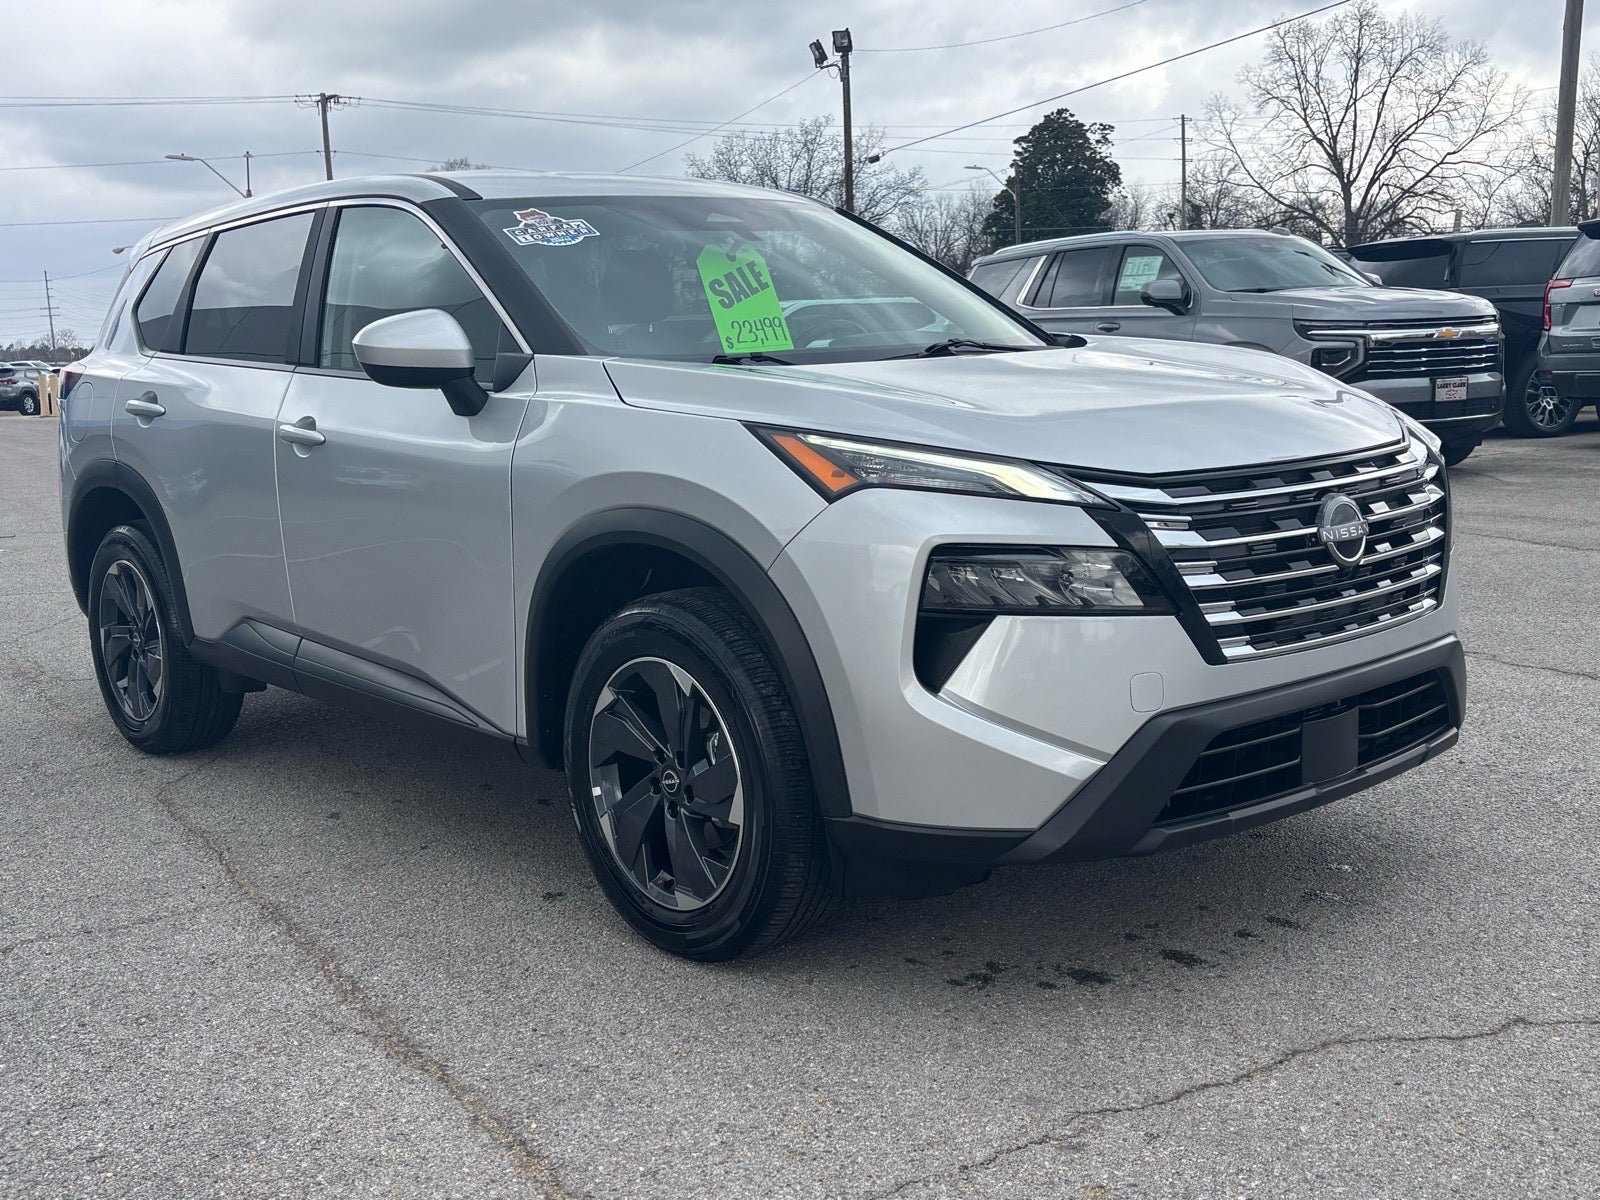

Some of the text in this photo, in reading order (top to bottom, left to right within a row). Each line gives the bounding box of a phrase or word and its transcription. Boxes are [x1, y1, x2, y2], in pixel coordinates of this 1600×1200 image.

[514, 222, 583, 236] CARFAX
[533, 229, 591, 240] OWNER
[708, 260, 770, 309] SALE
[1322, 523, 1369, 540] NISSAN
